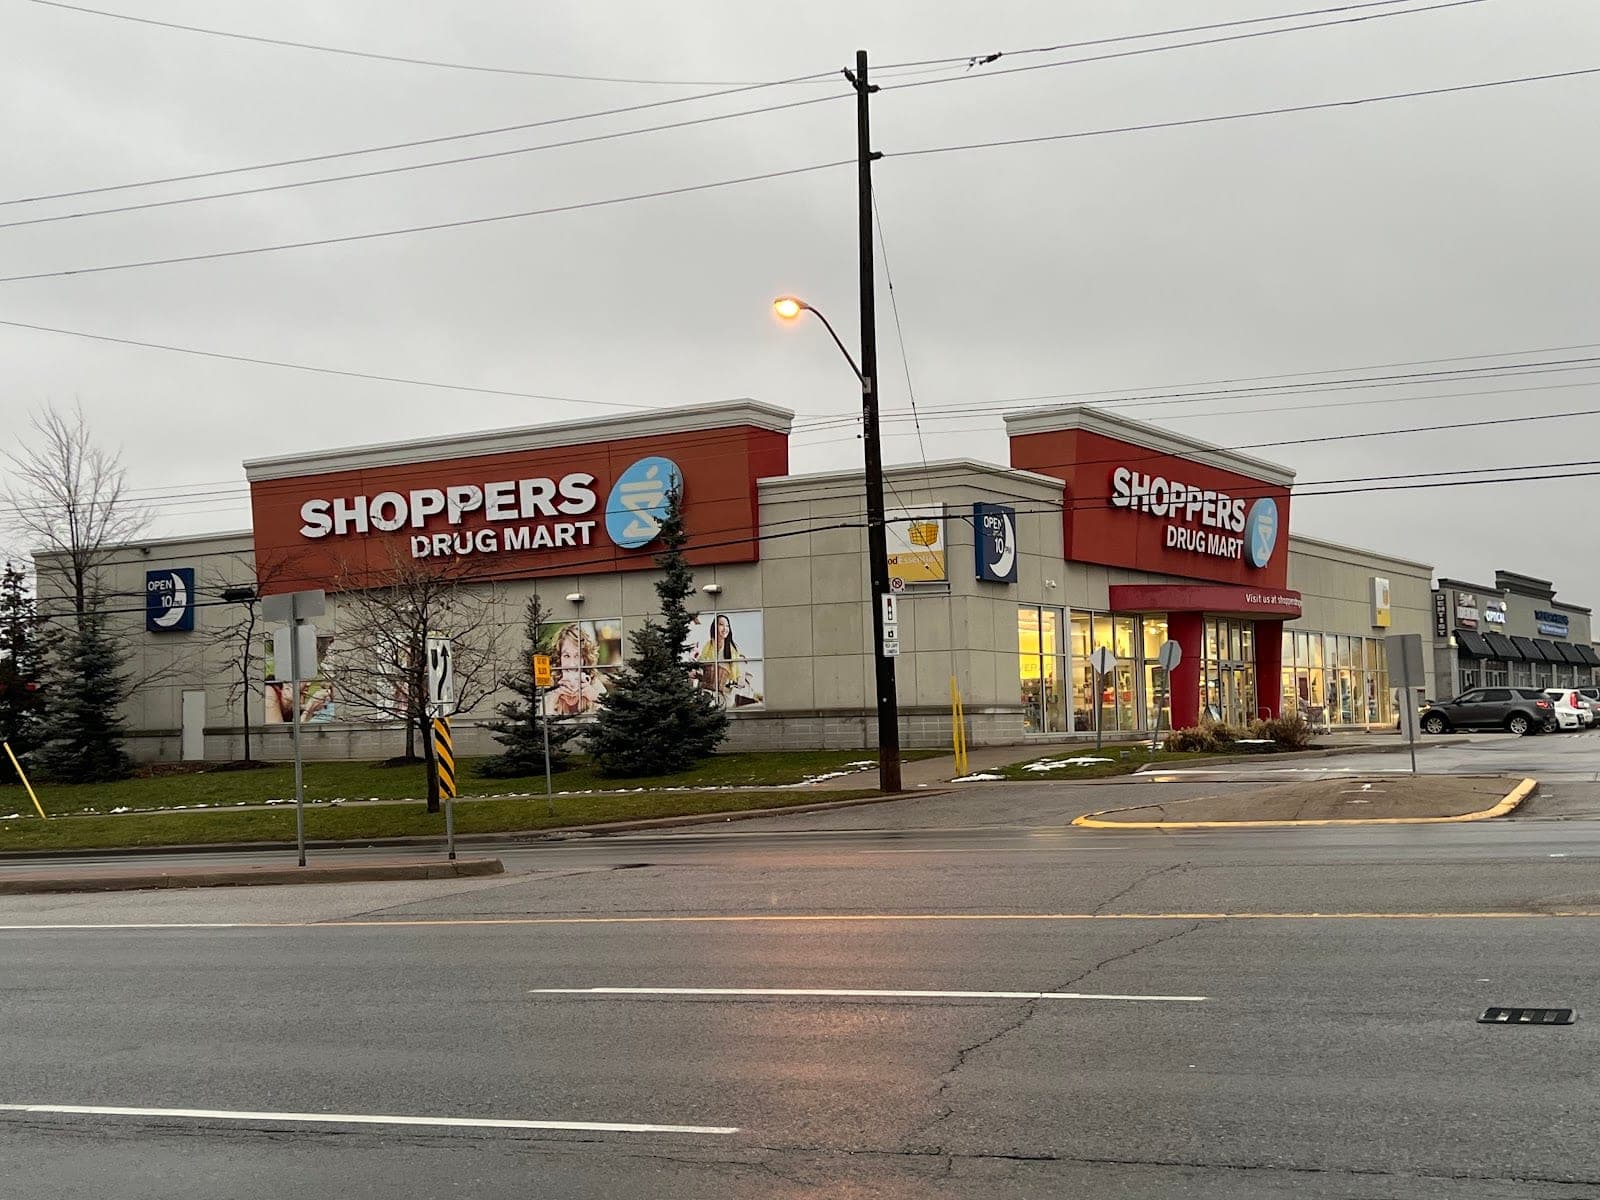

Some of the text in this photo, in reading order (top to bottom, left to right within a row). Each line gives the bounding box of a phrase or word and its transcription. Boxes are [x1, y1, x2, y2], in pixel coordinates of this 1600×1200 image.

[299, 473, 596, 538] SHOPPERS
[1111, 467, 1246, 533] SHOPPERS
[984, 515, 1003, 529] OPEN
[411, 520, 596, 559] DRUG MART
[995, 538, 1004, 553] 10
[1166, 525, 1244, 560] DRUG MART
[148, 579, 172, 591] OPEN
[161, 595, 172, 607] 10
[1245, 593, 1261, 603] Visit
[1262, 595, 1271, 604] us
[1271, 595, 1277, 604] at
[1436, 595, 1446, 636] DENTIST
[1485, 610, 1505, 623] OPTICAL
